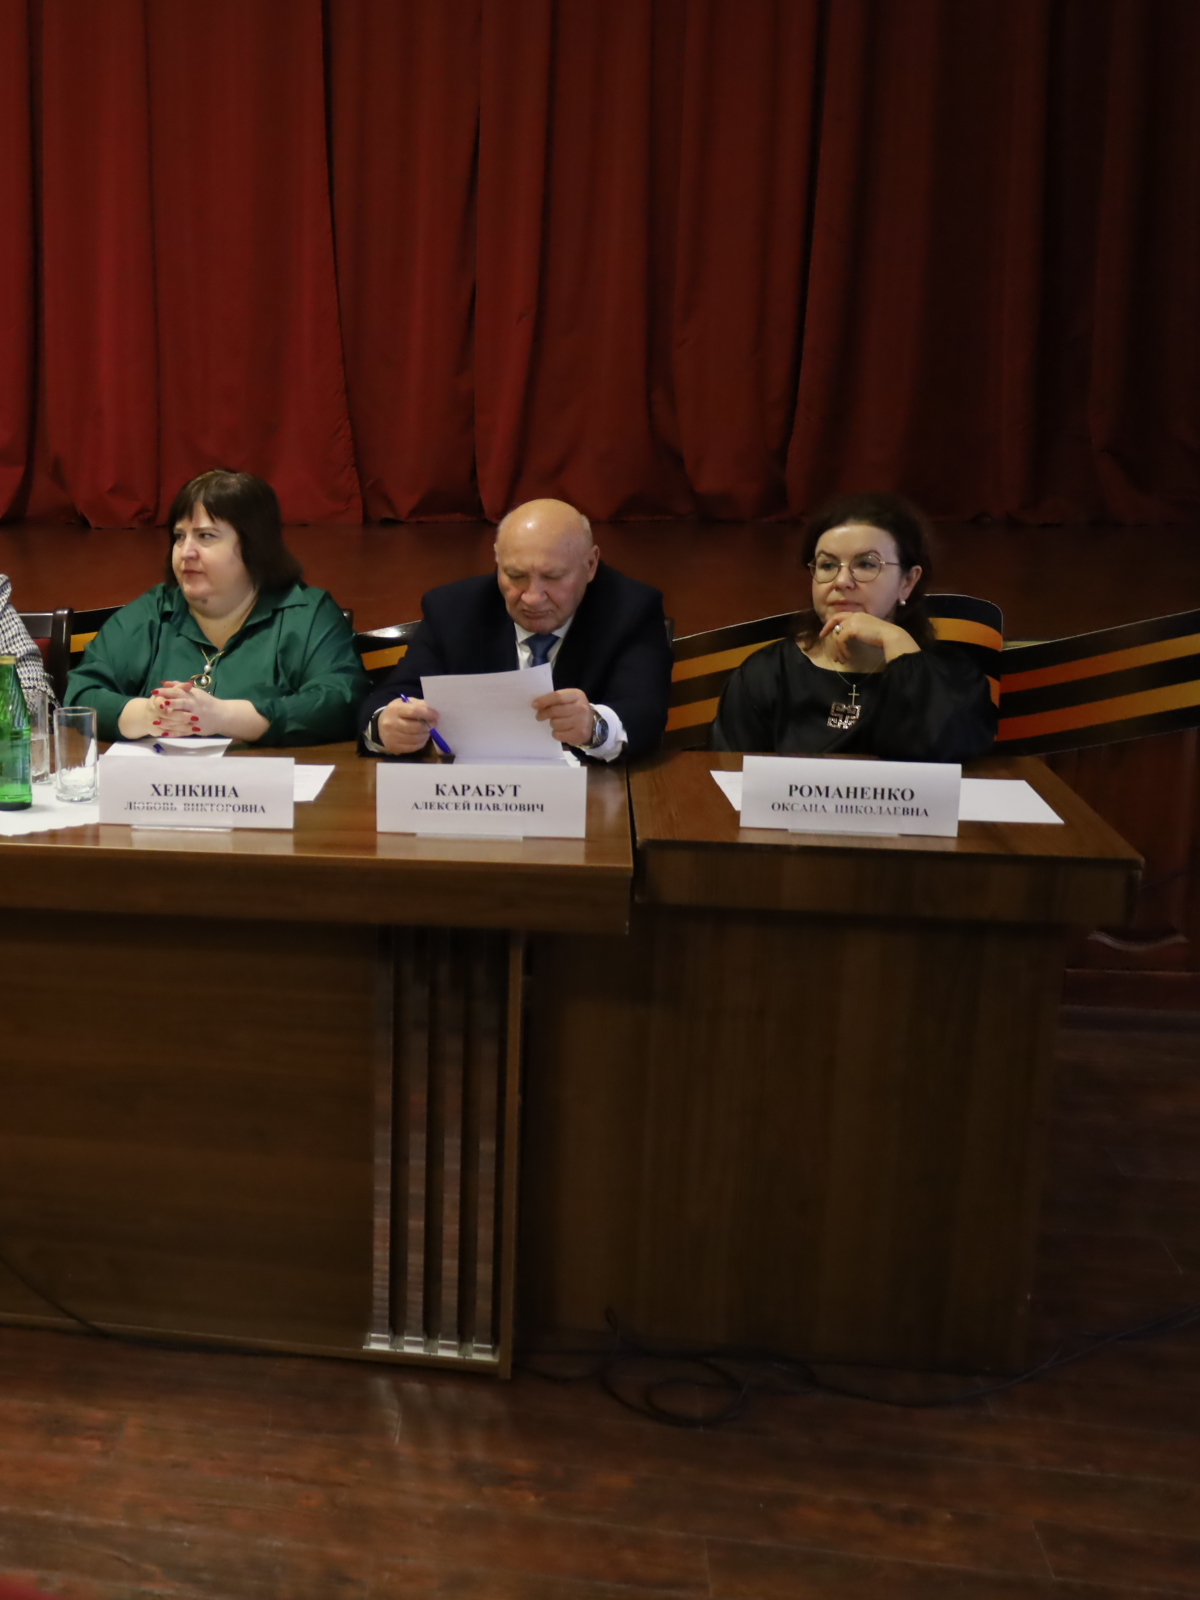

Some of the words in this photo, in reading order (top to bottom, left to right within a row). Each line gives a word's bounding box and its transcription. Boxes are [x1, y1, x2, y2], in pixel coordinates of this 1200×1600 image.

[150, 783, 239, 798] ХЕНКИНА
[434, 783, 521, 797] КАРАБУТ
[788, 784, 915, 801] РОМАНЕНКО
[124, 801, 177, 812] ЛЮБОВЬ
[183, 802, 266, 813] ВИКТОРОВНА
[411, 800, 470, 811] АЛЕКСЕЙ
[474, 802, 544, 812] ПАВЛОВИЧ
[771, 802, 827, 813] ОКСАНА
[835, 804, 929, 817] НИКОЛАЕВНА
